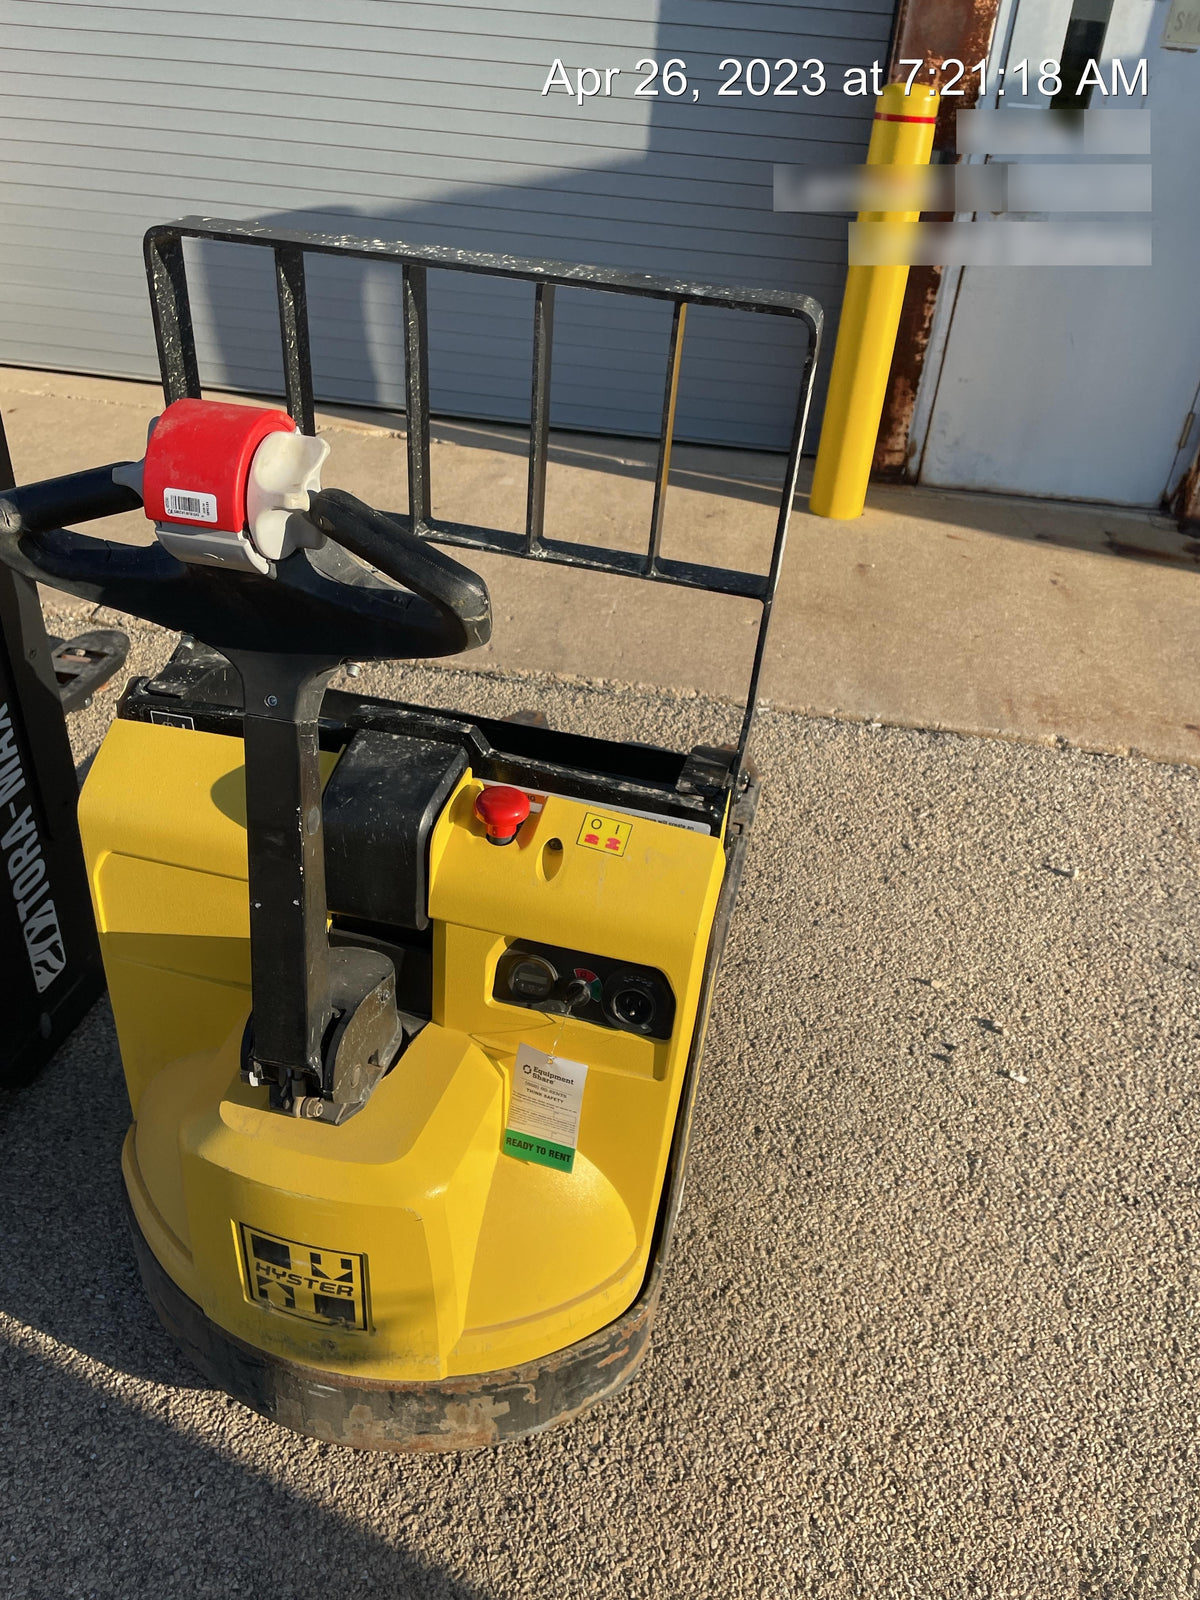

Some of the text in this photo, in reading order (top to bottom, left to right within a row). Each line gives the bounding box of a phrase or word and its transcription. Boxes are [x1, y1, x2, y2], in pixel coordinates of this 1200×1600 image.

[532, 1073, 554, 1085] Share
[533, 1066, 574, 1085] Equipment
[526, 1088, 564, 1103] THINK SAFETY
[506, 1137, 571, 1163] READY TO RENT
[256, 1262, 354, 1296] HYSTER
